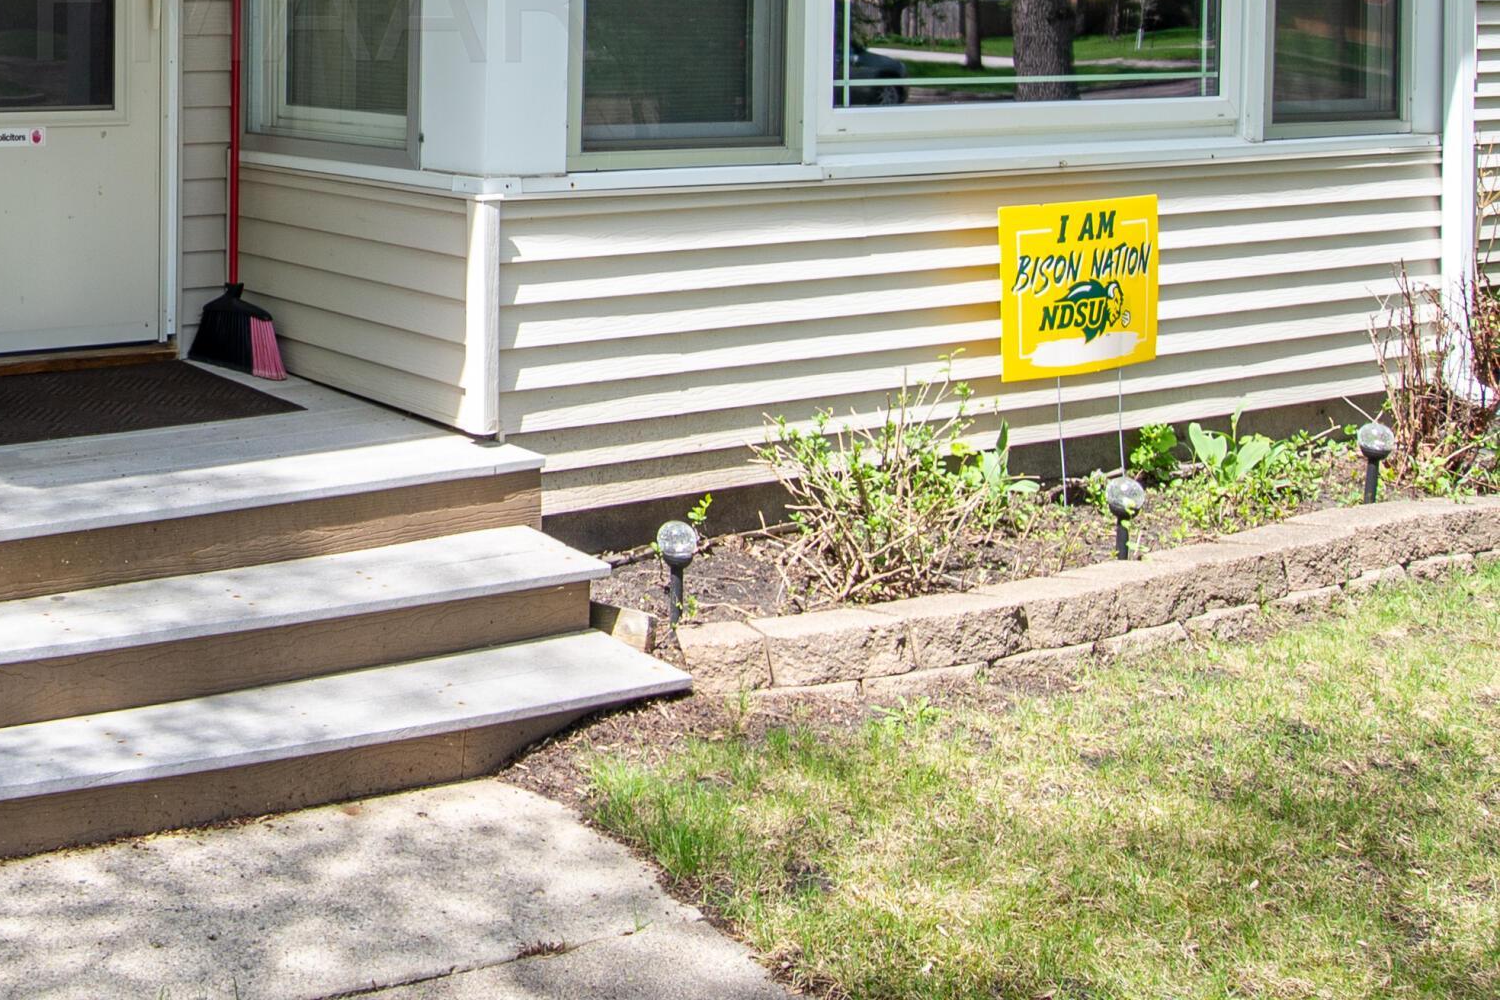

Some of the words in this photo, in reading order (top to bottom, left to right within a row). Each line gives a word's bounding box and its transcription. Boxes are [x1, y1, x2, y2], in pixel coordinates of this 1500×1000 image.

[1056, 215, 1069, 243] I
[1077, 210, 1116, 241] AM
[1011, 250, 1084, 297] BISON
[1090, 240, 1153, 281] NATION
[1038, 298, 1107, 332] NDSU
